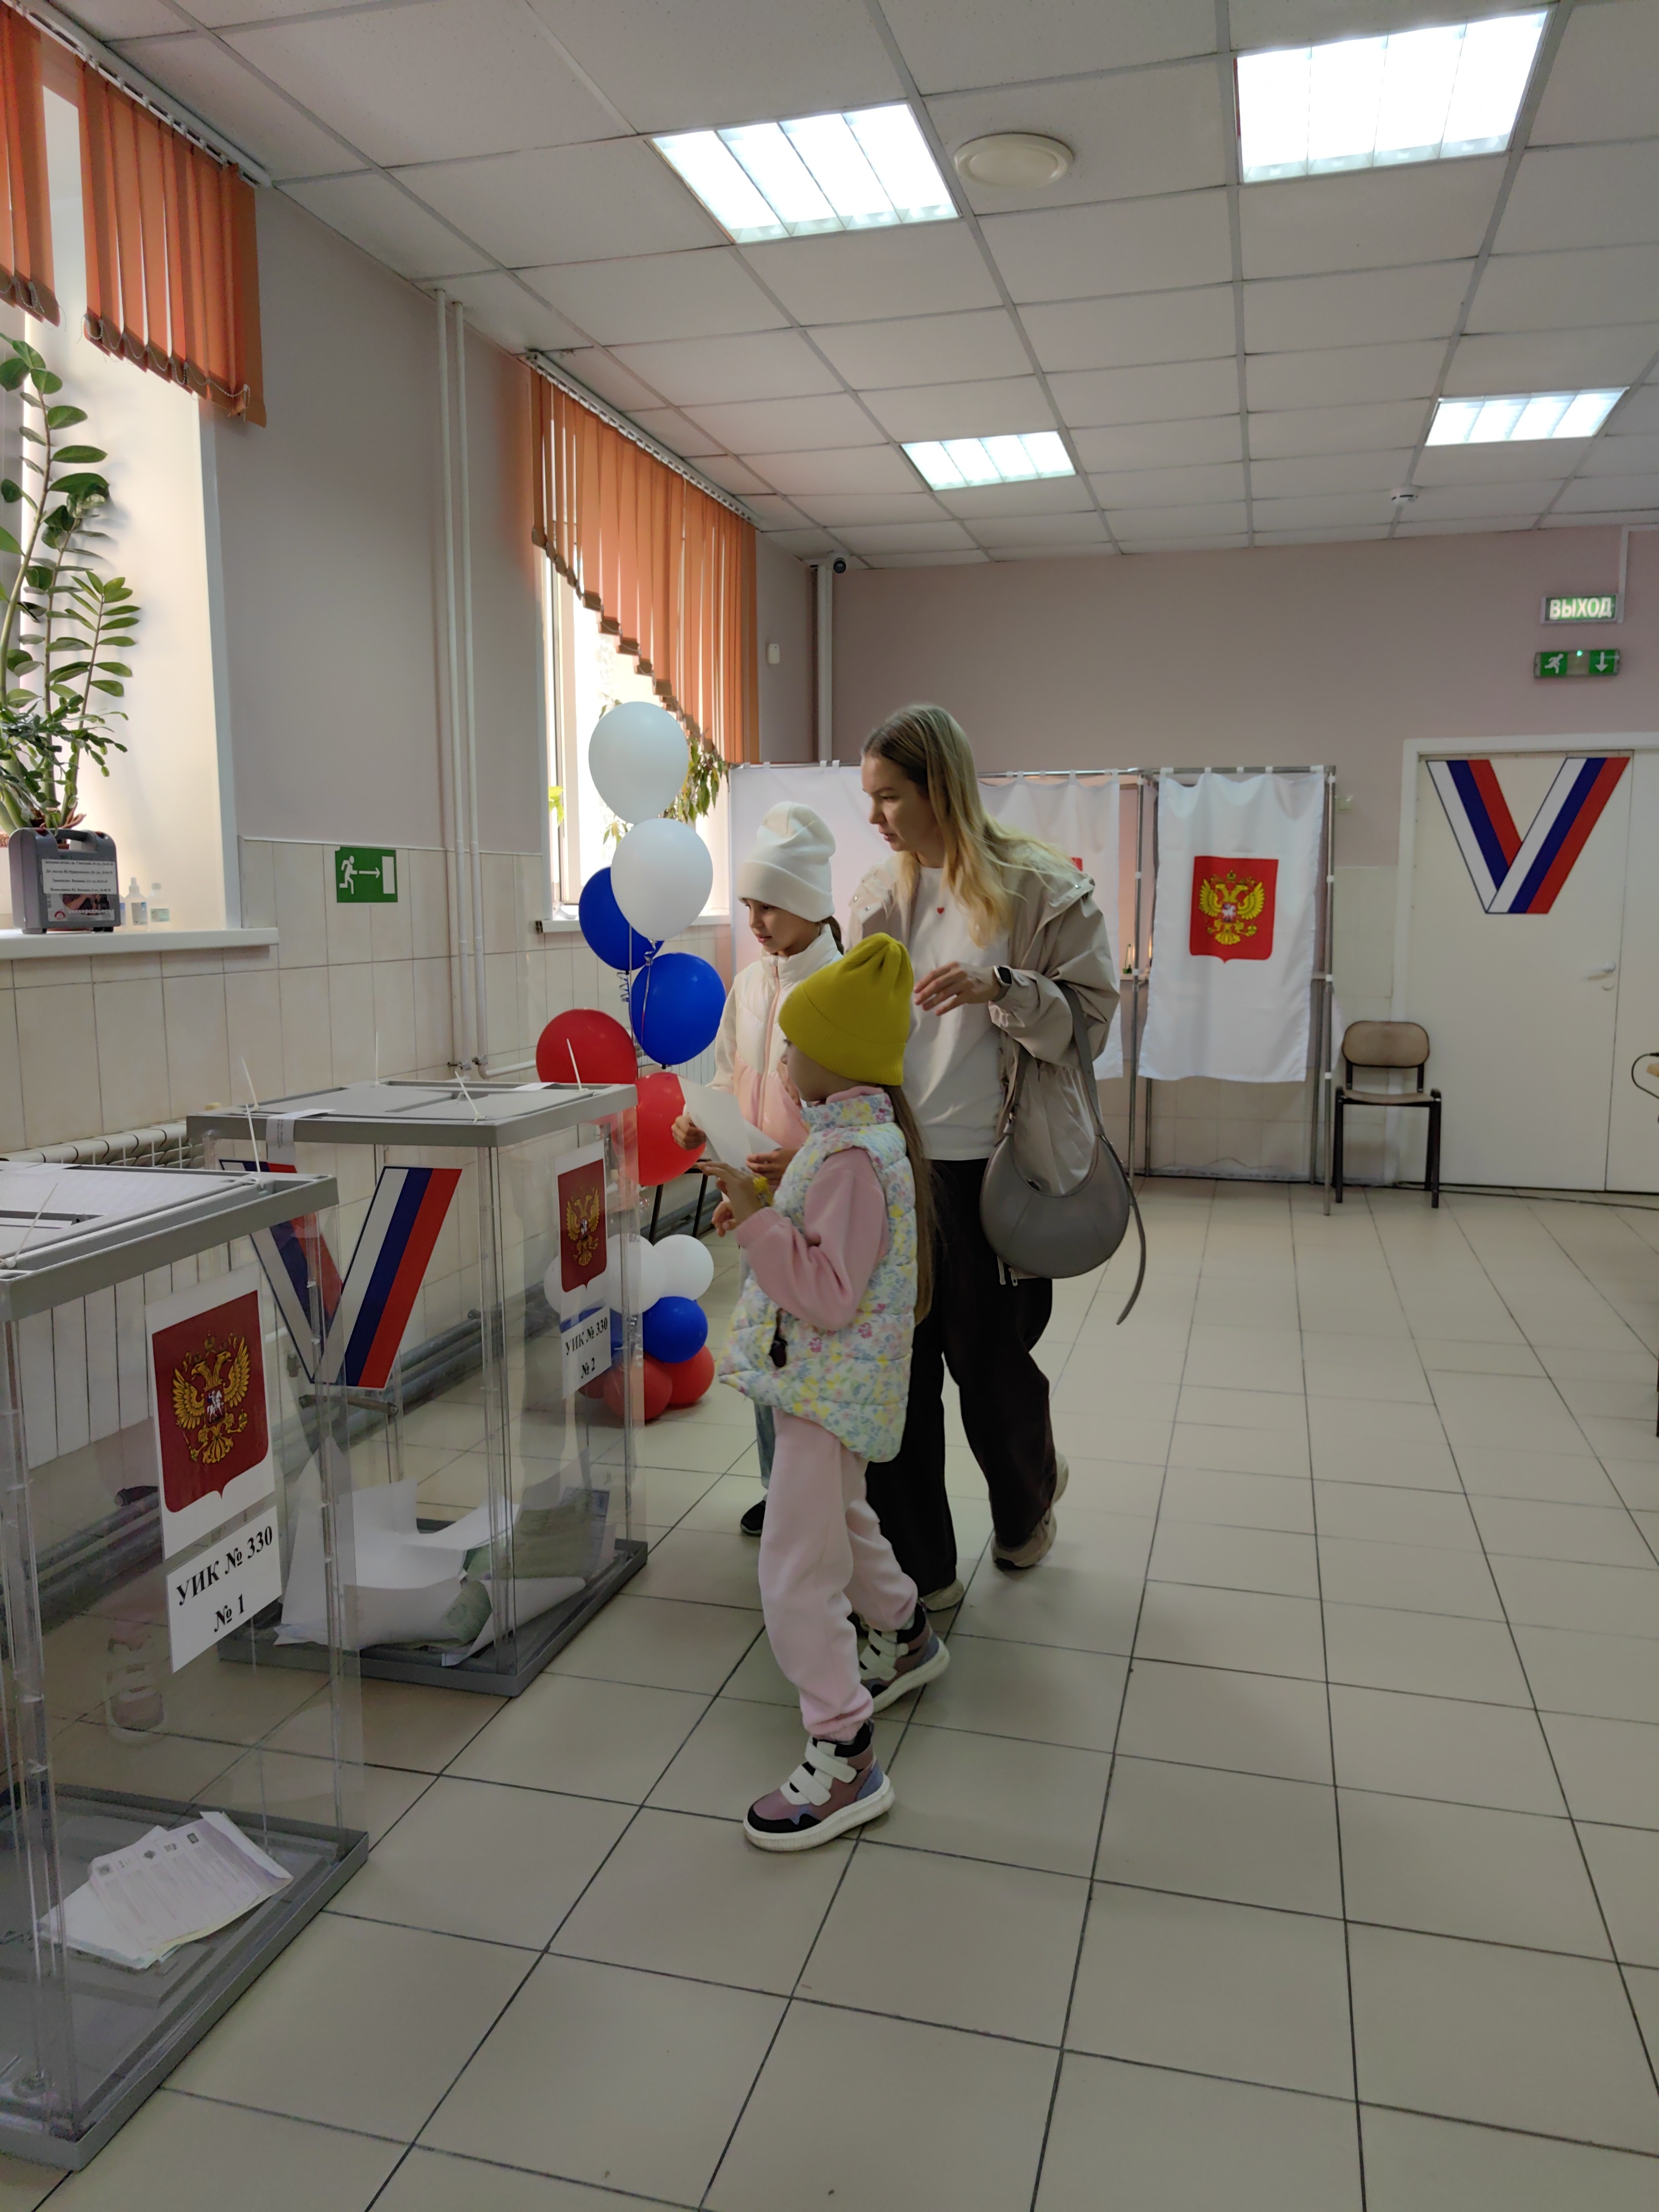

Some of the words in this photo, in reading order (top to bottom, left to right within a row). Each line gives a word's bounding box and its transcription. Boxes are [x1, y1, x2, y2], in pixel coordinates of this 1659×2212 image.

[1549, 597, 1611, 619] ВЫХОД
[565, 1331, 584, 1355] УИК
[586, 1326, 595, 1343] №
[596, 1317, 608, 1336] 330
[581, 1362, 590, 1379] №
[591, 1357, 596, 1372] 2
[176, 1560, 220, 1606] УИК
[225, 1547, 243, 1575] №
[247, 1526, 273, 1559] 330
[214, 1605, 232, 1633] №
[238, 1593, 245, 1615] 1
